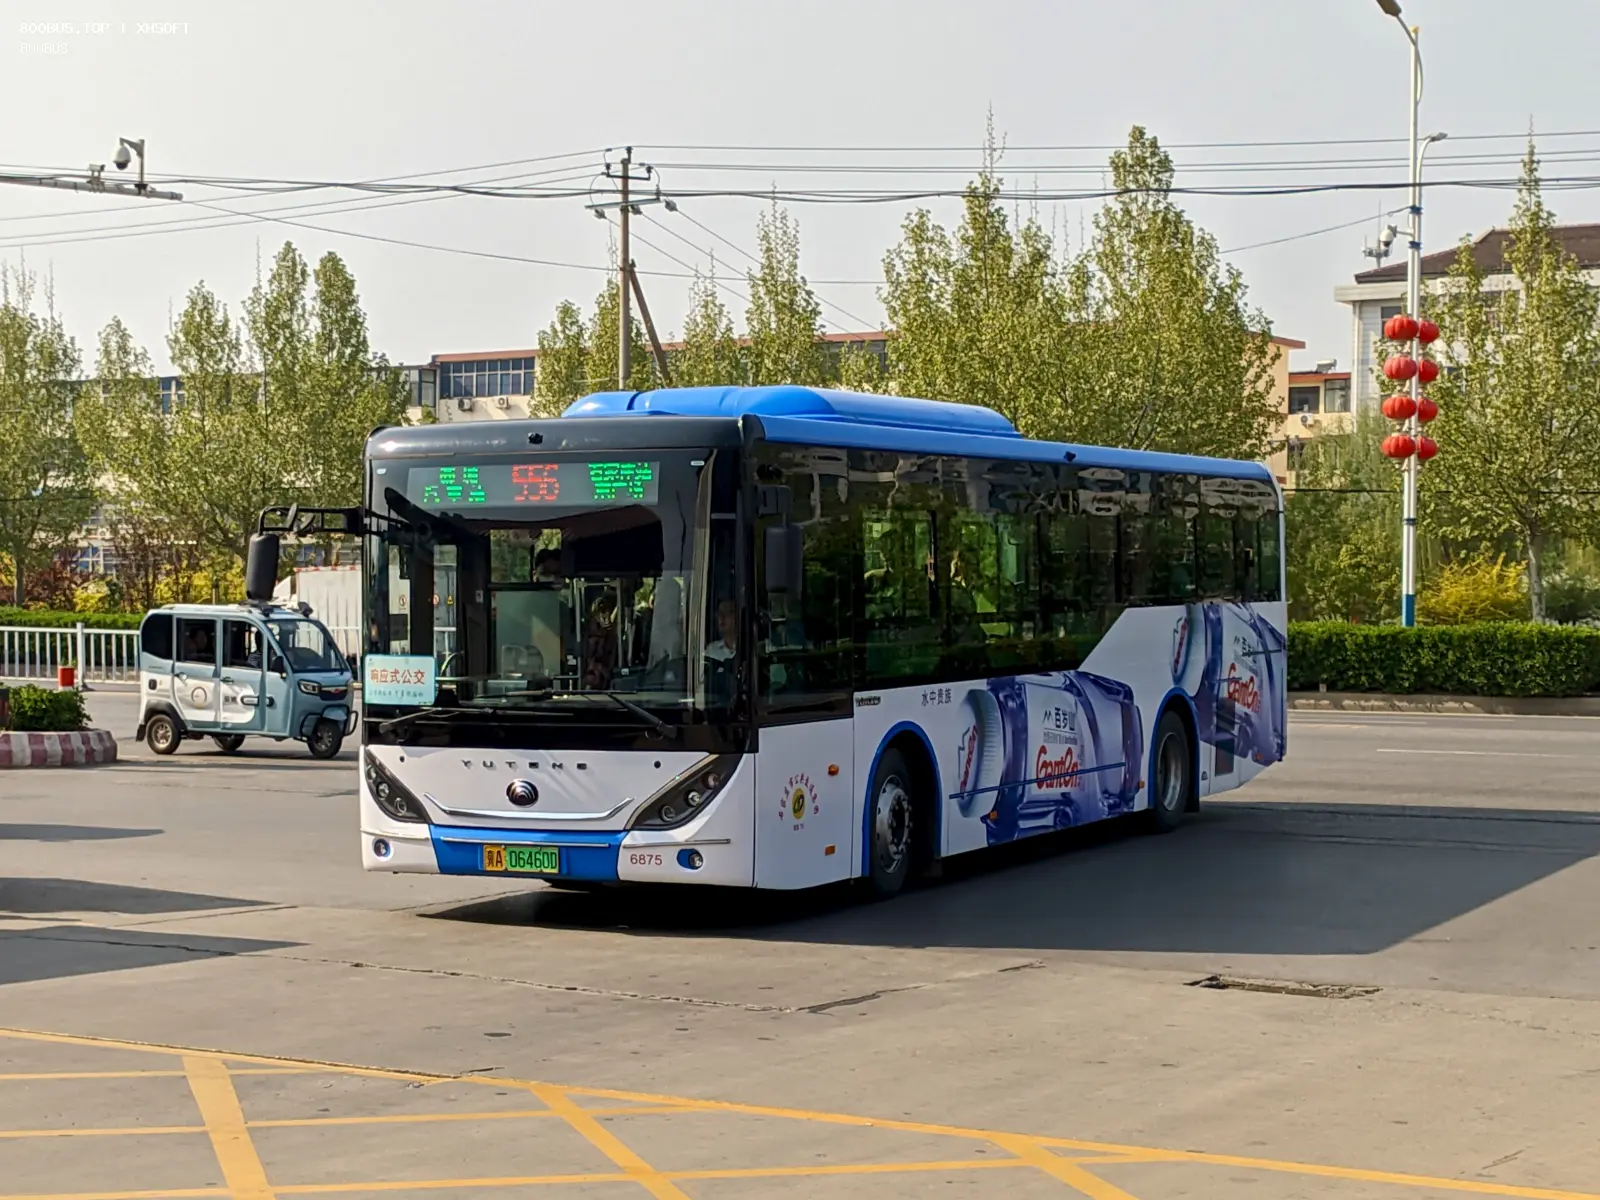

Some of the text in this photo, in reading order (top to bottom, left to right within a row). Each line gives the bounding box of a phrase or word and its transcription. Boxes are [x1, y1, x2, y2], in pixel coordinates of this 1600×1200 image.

[370, 668, 426, 685] 响应式公交
[921, 687, 952, 707] 水中贵族
[1054, 707, 1076, 731] 百岁山
[630, 853, 662, 866] 6875
